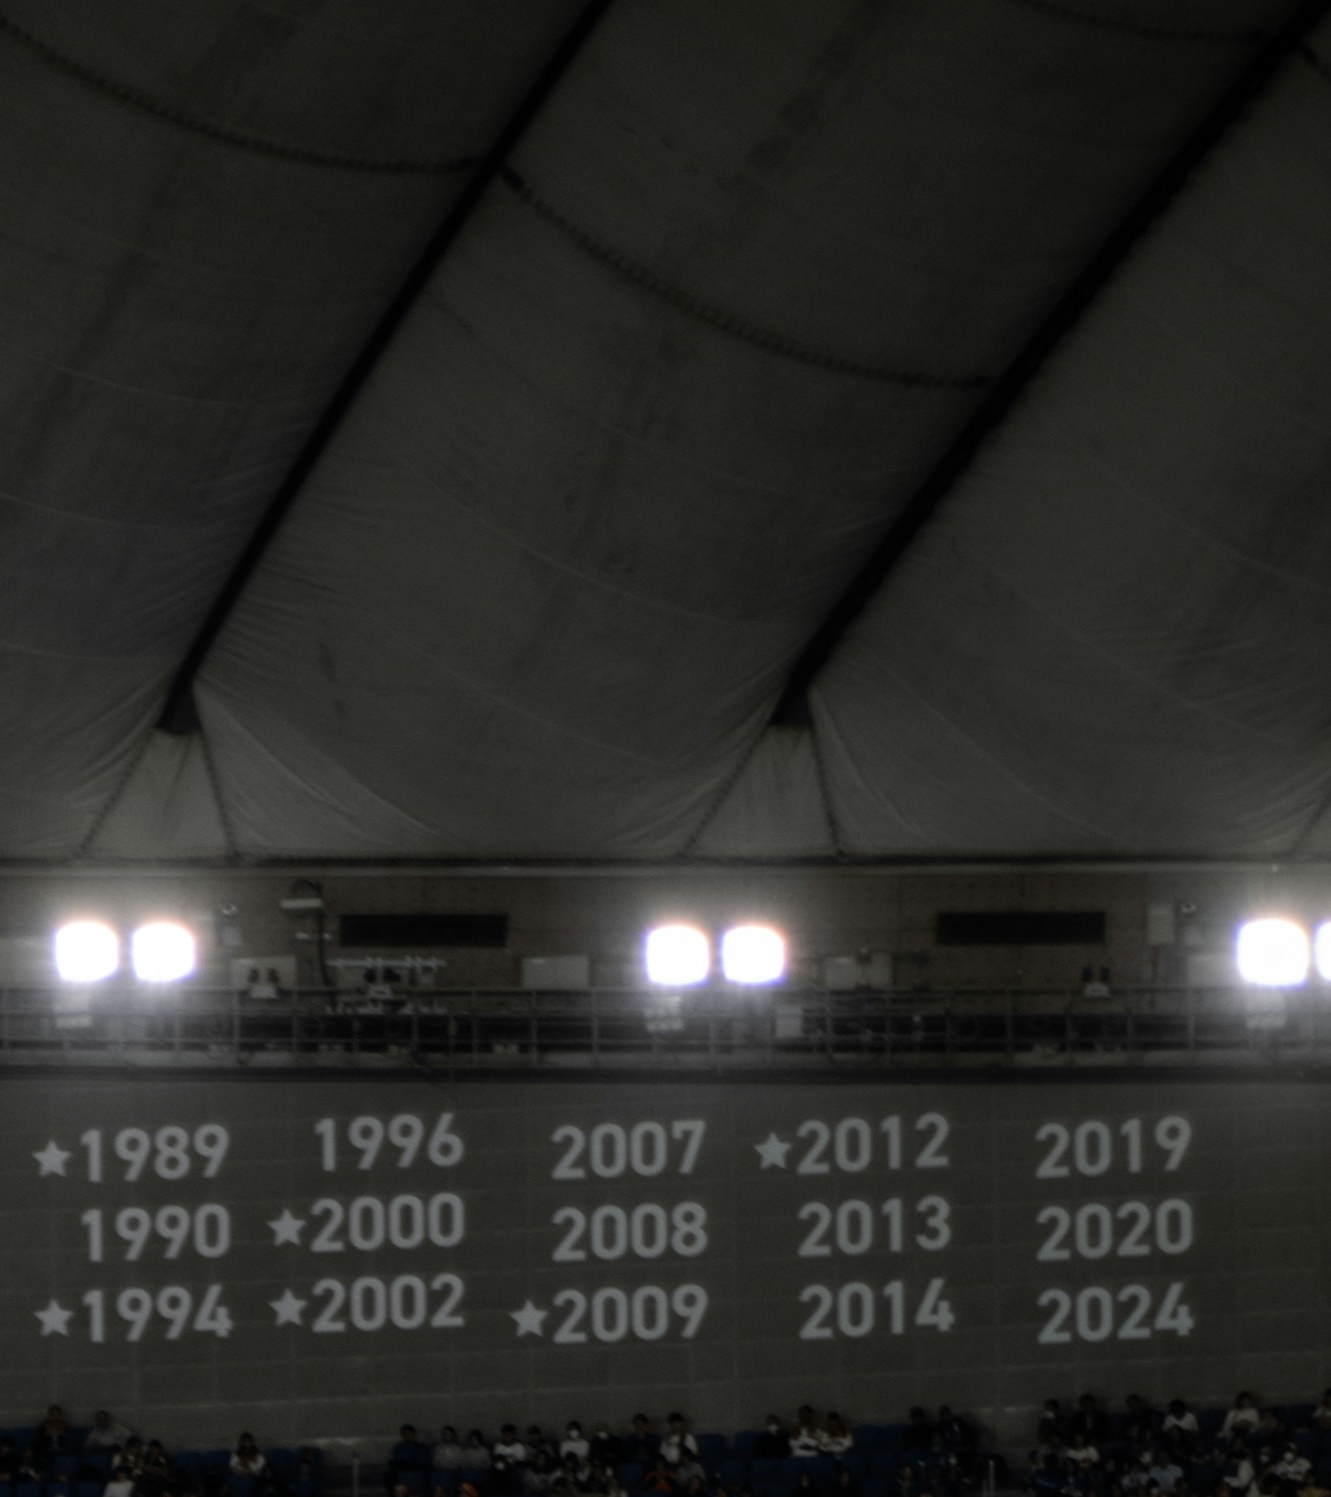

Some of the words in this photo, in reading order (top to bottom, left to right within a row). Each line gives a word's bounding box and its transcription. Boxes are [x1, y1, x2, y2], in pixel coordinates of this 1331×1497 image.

[80, 1123, 230, 1184] 1989
[313, 1112, 464, 1173] 1996
[550, 1120, 706, 1181] 2007
[795, 1112, 950, 1175] 2012
[1035, 1115, 1193, 1180] 2019
[80, 1204, 231, 1263] 1990
[309, 1193, 465, 1254] 2000
[550, 1201, 708, 1262] 2008
[796, 1195, 951, 1258] 2013
[1036, 1198, 1194, 1262] 2020
[81, 1284, 234, 1344] 1994
[310, 1273, 466, 1334] 2002
[551, 1284, 709, 1345] 2009
[799, 1277, 955, 1340] 2014
[1037, 1281, 1195, 1345] 2024
